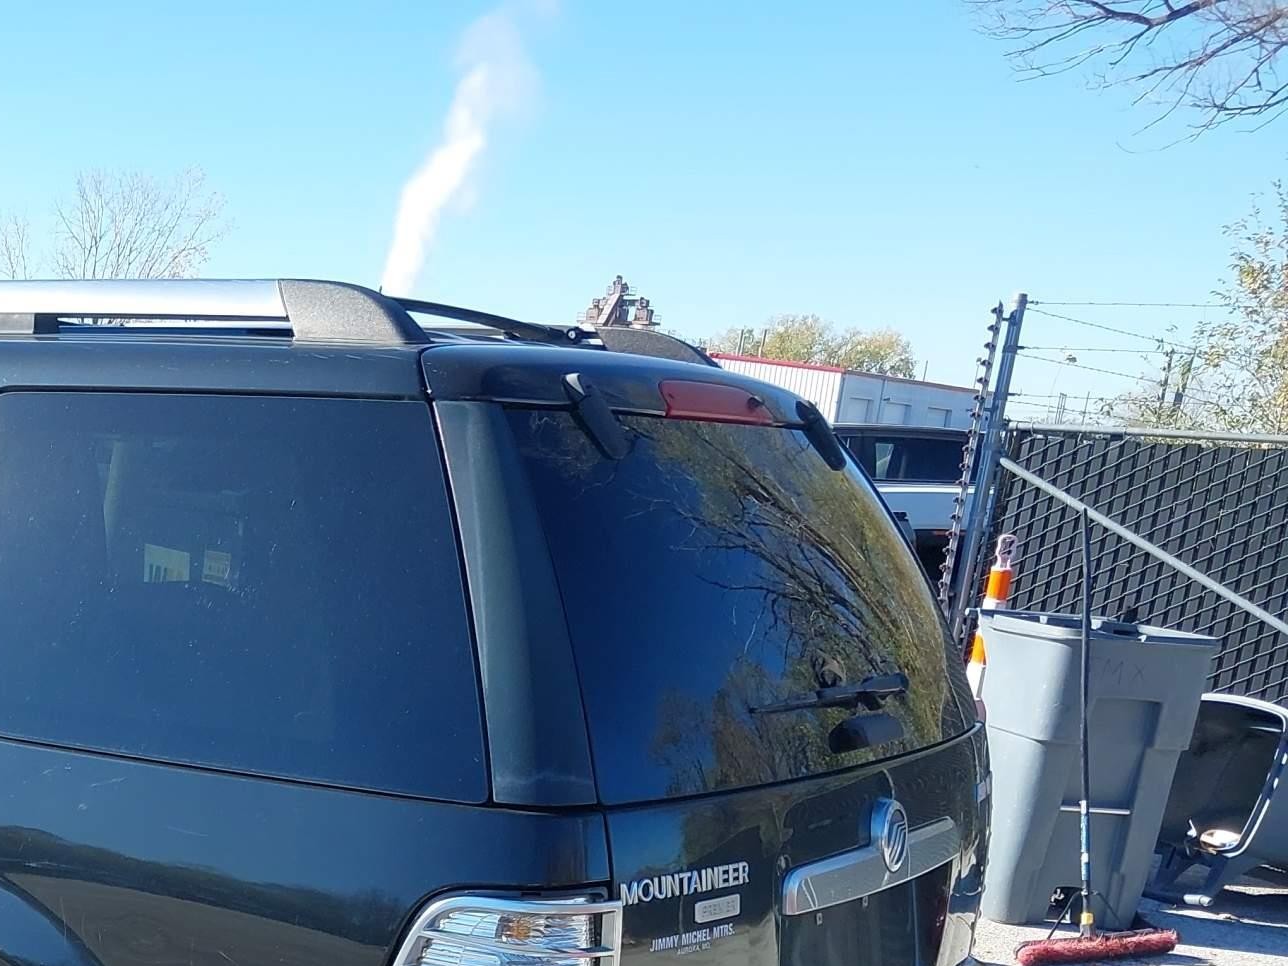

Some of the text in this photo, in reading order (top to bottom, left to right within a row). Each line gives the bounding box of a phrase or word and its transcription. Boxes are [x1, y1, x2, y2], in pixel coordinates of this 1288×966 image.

[620, 861, 750, 907] MOUNTAINEER
[649, 923, 736, 953] JIMMY MICHEL MTRS.
